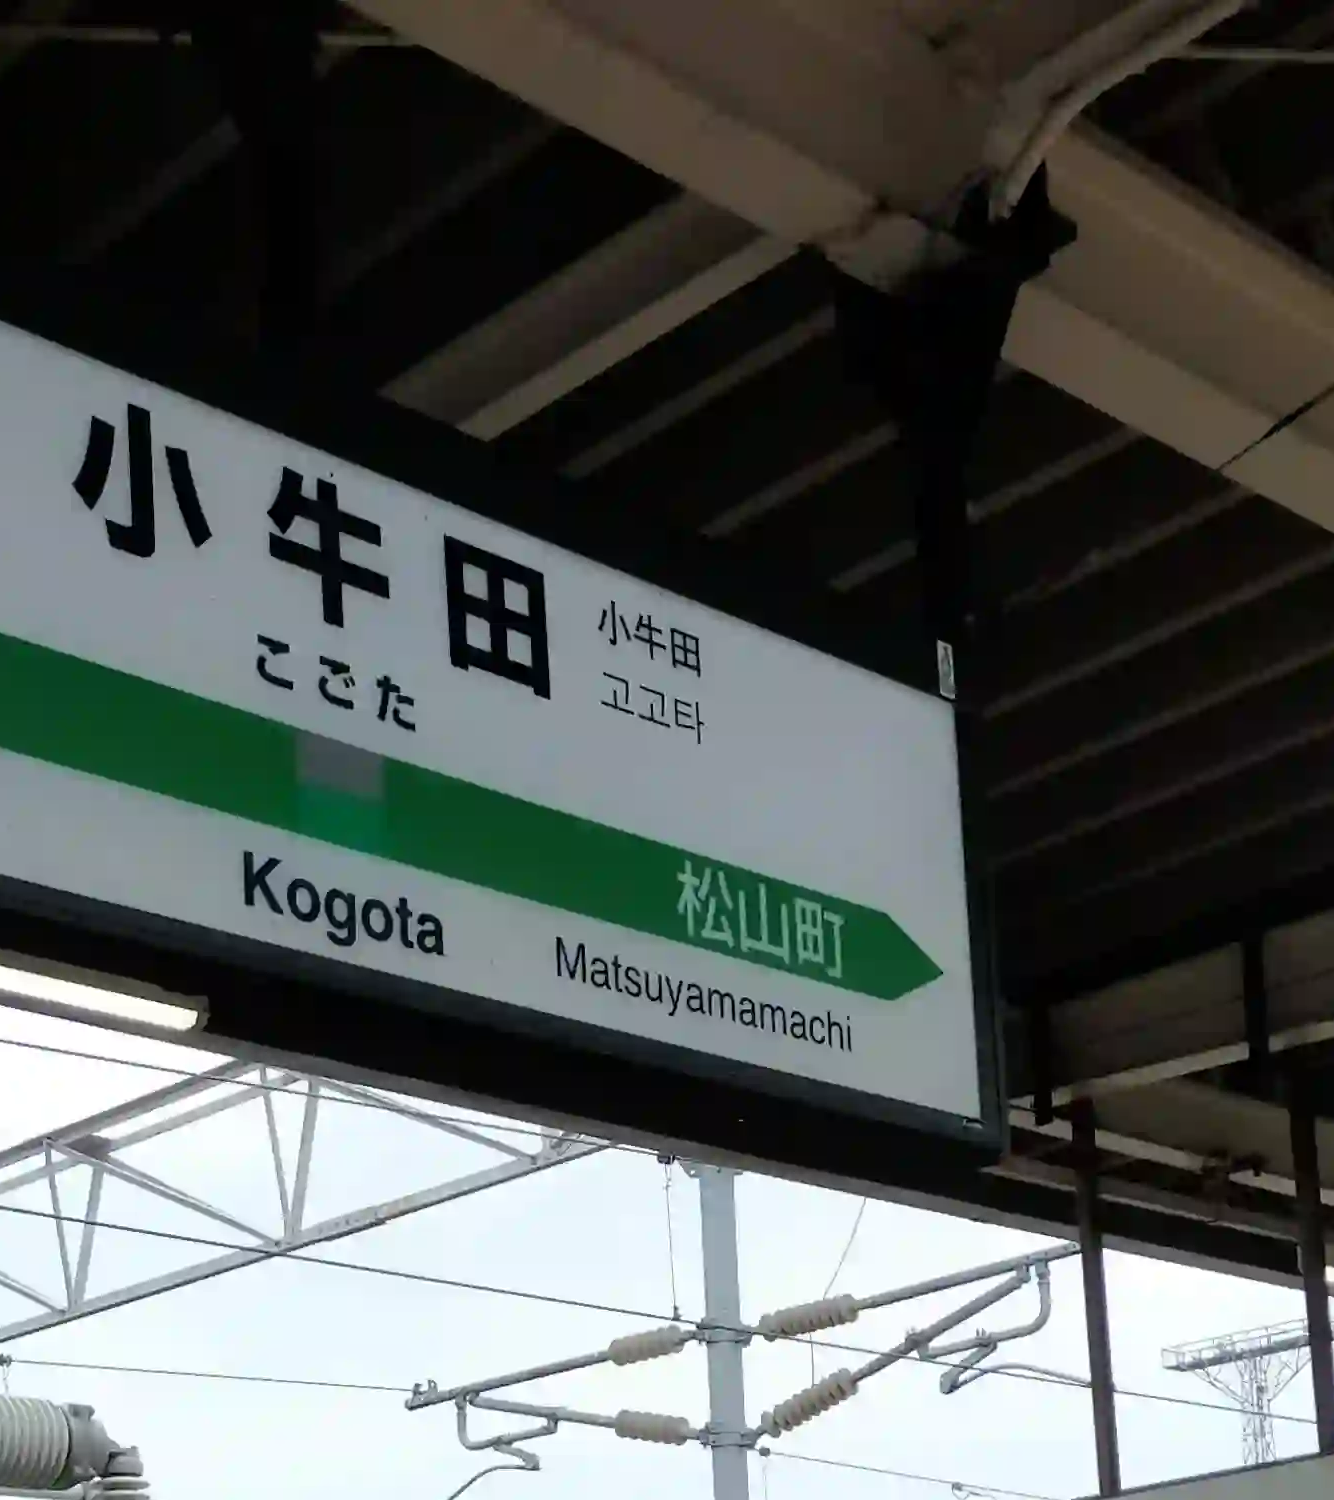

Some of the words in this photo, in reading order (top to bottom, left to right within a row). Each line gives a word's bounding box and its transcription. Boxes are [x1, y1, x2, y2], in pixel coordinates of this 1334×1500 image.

[72, 403, 553, 699] 小牛田
[254, 632, 419, 734] こごた
[597, 598, 704, 679] 小牛田
[599, 669, 707, 746] 고고타
[241, 850, 445, 957] Kogota
[676, 857, 846, 981] 松山町
[554, 936, 853, 1054] Matsuyamamachi
